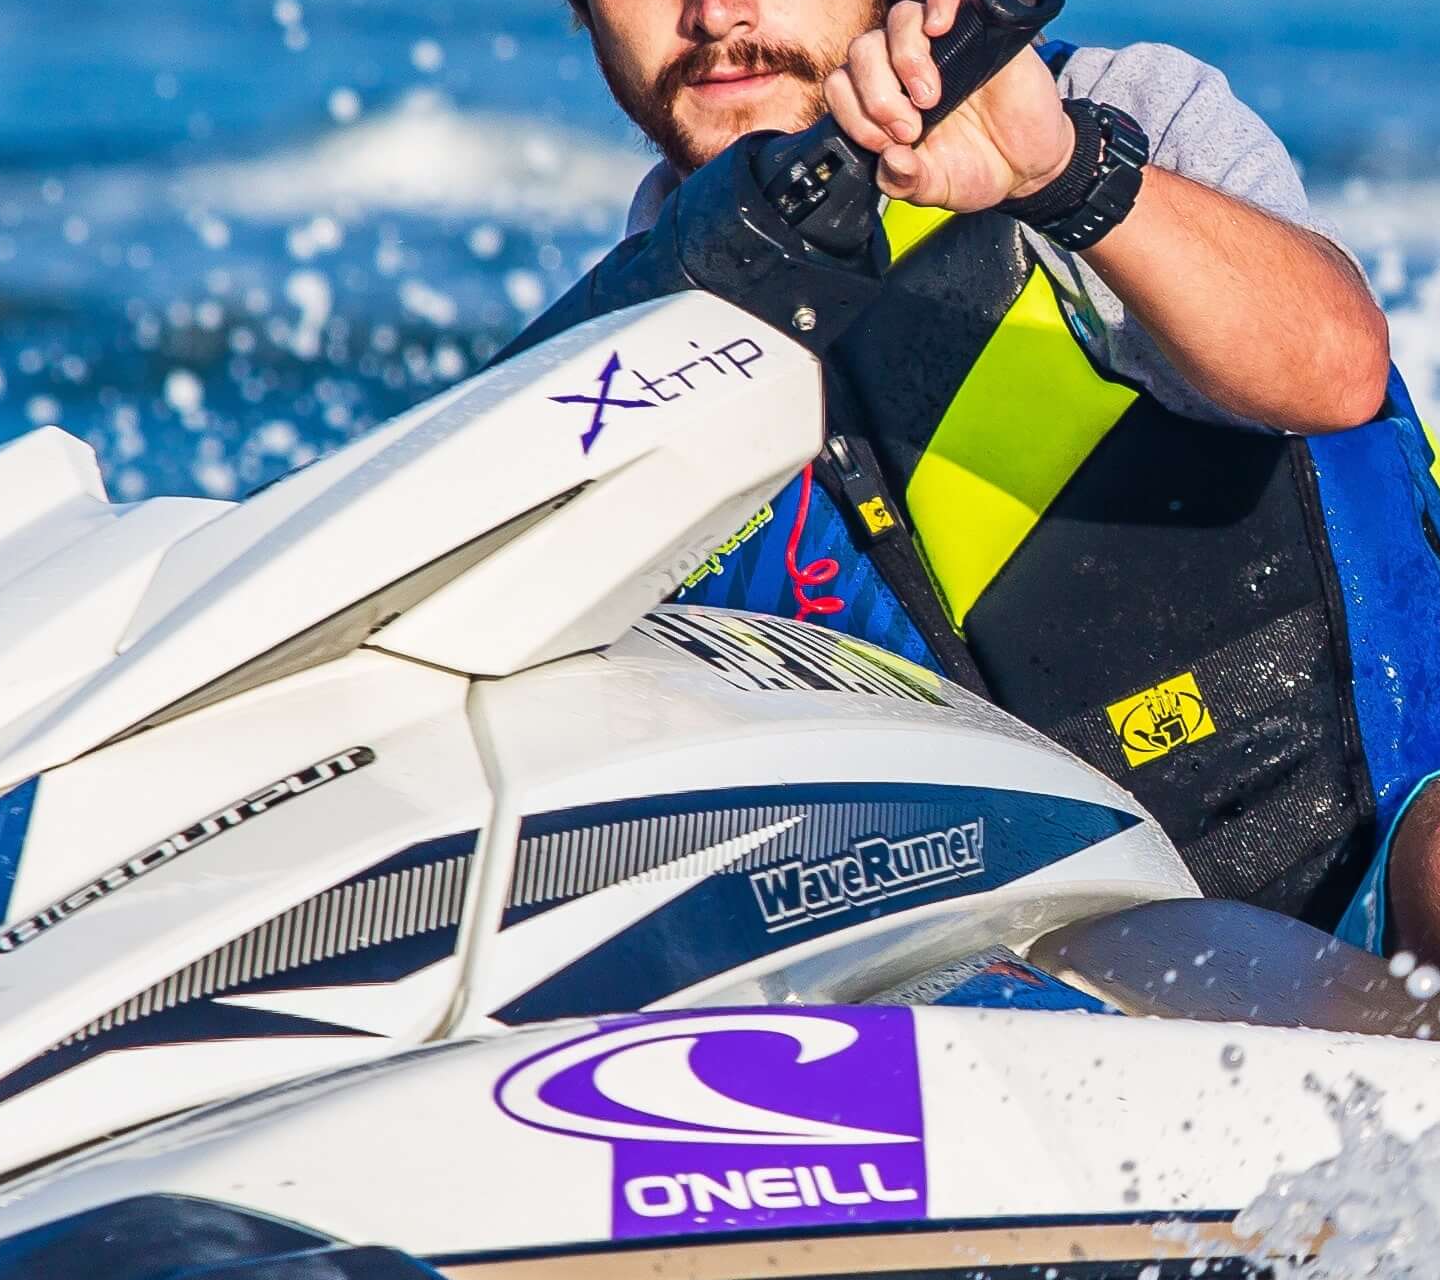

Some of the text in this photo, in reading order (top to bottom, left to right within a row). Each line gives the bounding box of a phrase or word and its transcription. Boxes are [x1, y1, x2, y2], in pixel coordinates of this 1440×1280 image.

[546, 337, 764, 456] Xtrip
[750, 818, 984, 931] WaveRunner
[623, 1163, 918, 1217] O'NEILL
